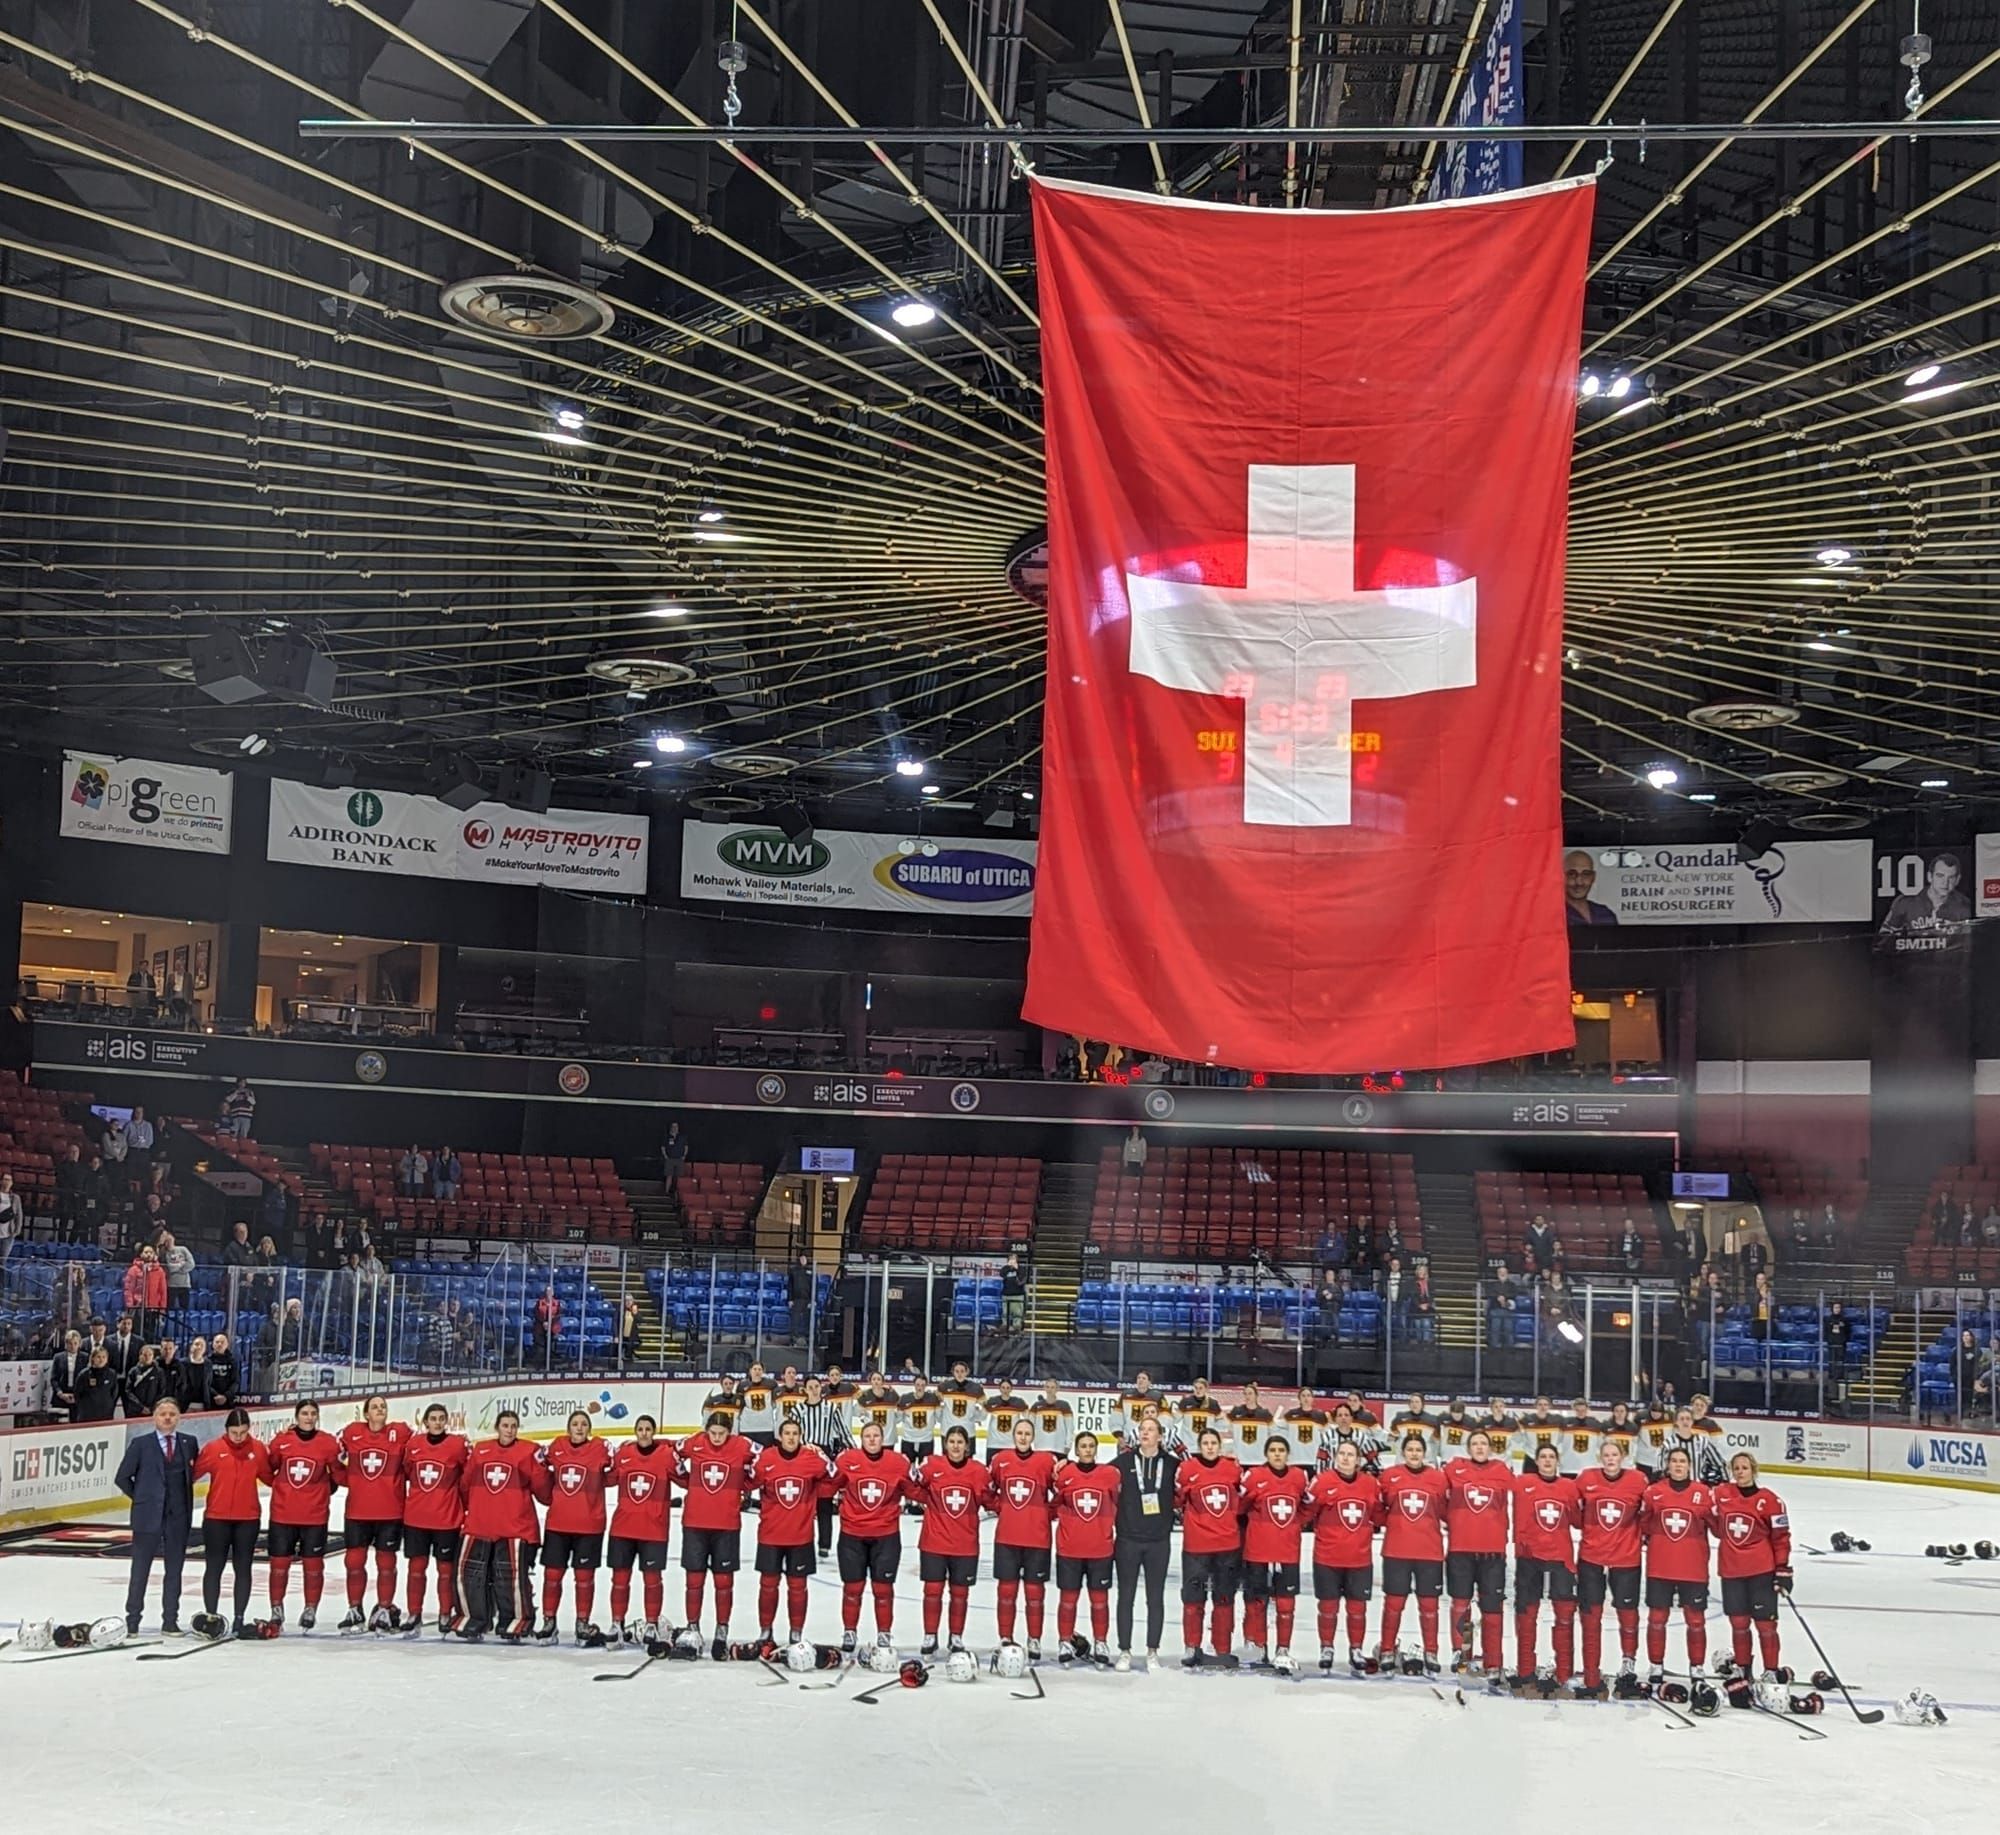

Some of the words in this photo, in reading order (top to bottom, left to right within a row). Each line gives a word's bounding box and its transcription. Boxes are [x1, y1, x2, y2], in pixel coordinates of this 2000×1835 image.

[108, 777, 216, 824] pjgreen
[78, 821, 106, 831] Official
[108, 826, 133, 835] Printer
[136, 827, 144, 836] of
[146, 828, 158, 838] the
[160, 831, 181, 841] Utica
[183, 833, 213, 844] Comets
[178, 816, 189, 826] do
[190, 819, 224, 832] printing
[288, 825, 437, 853] ADIRONDACK
[502, 826, 642, 851] MASTROVITO
[333, 848, 394, 866] BANK
[499, 840, 637, 861] HYUNDAI
[736, 839, 813, 866] MVM
[1655, 848, 1739, 872] Qandah
[693, 873, 741, 887] Mohawk
[744, 877, 777, 890] Valley
[780, 880, 836, 895] Materials,
[898, 864, 963, 884] SUBARU
[966, 869, 981, 885] of
[983, 868, 1030, 887] UTICA
[1621, 873, 1671, 883] CENTRAL
[1675, 874, 1702, 883] NEW
[1705, 872, 1734, 882] YORK
[1877, 855, 1924, 897] 10
[727, 889, 752, 898] Mulch
[759, 892, 788, 901] Topsoil
[794, 894, 818, 903] Stone
[1621, 886, 1664, 897] BRAIN
[1668, 888, 1690, 896] AND
[1694, 886, 1734, 896] SPINE
[1621, 900, 1735, 911] NEUROSURGERY
[1895, 938, 1947, 950] SMITH
[109, 1033, 147, 1060] ais
[833, 1079, 868, 1102] ais
[1533, 1098, 1569, 1122] ais
[568, 1229, 584, 1238] 107
[1011, 1244, 1027, 1252] 108
[1083, 1246, 1100, 1254] 109
[1077, 1416, 1103, 1431] FOR
[1727, 1433, 1759, 1448] COM
[43, 1441, 108, 1477] TISSOT
[1929, 1439, 1987, 1467] NCSA
[1692, 1491, 1702, 1504] A
[1756, 1498, 1766, 1511] C
